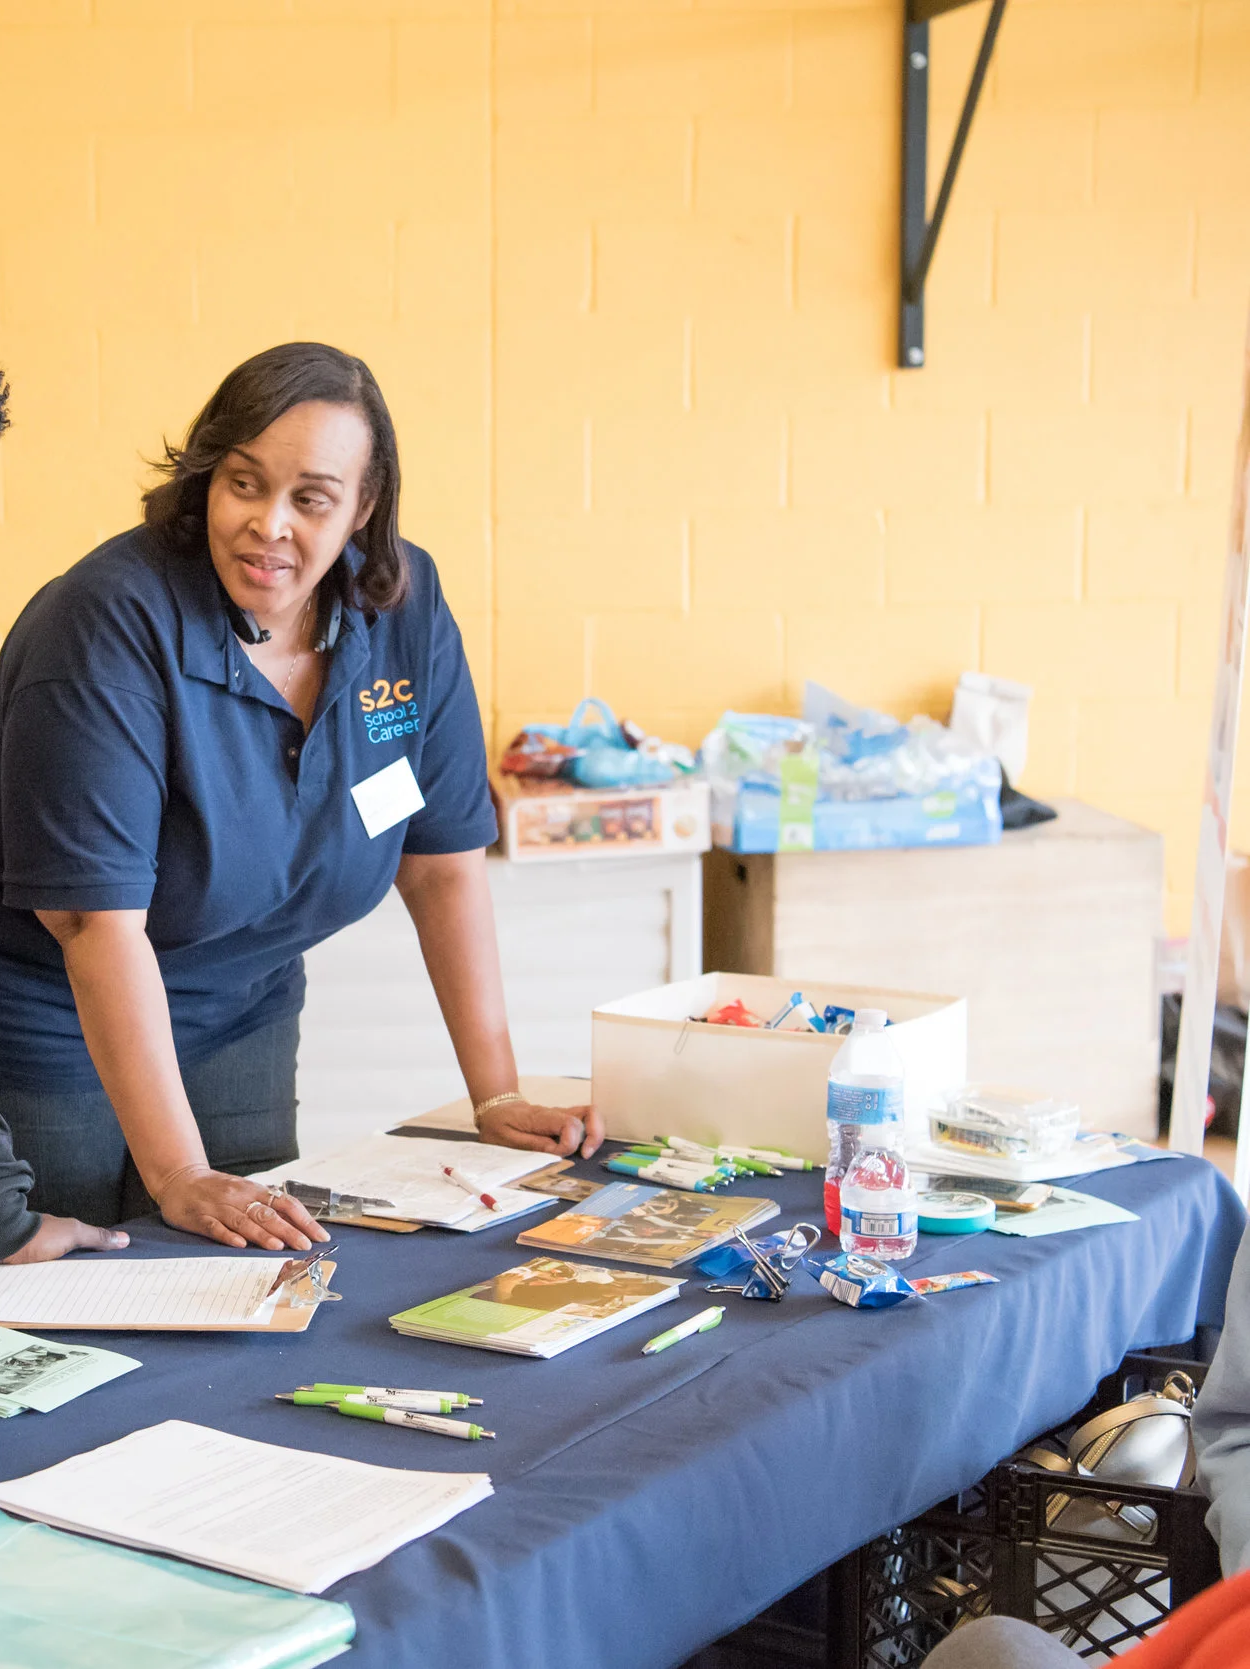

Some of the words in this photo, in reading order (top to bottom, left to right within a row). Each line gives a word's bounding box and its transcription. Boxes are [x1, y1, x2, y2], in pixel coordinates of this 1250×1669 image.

[364, 706, 406, 728] School
[409, 702, 418, 716] 2
[368, 718, 420, 744] Career
